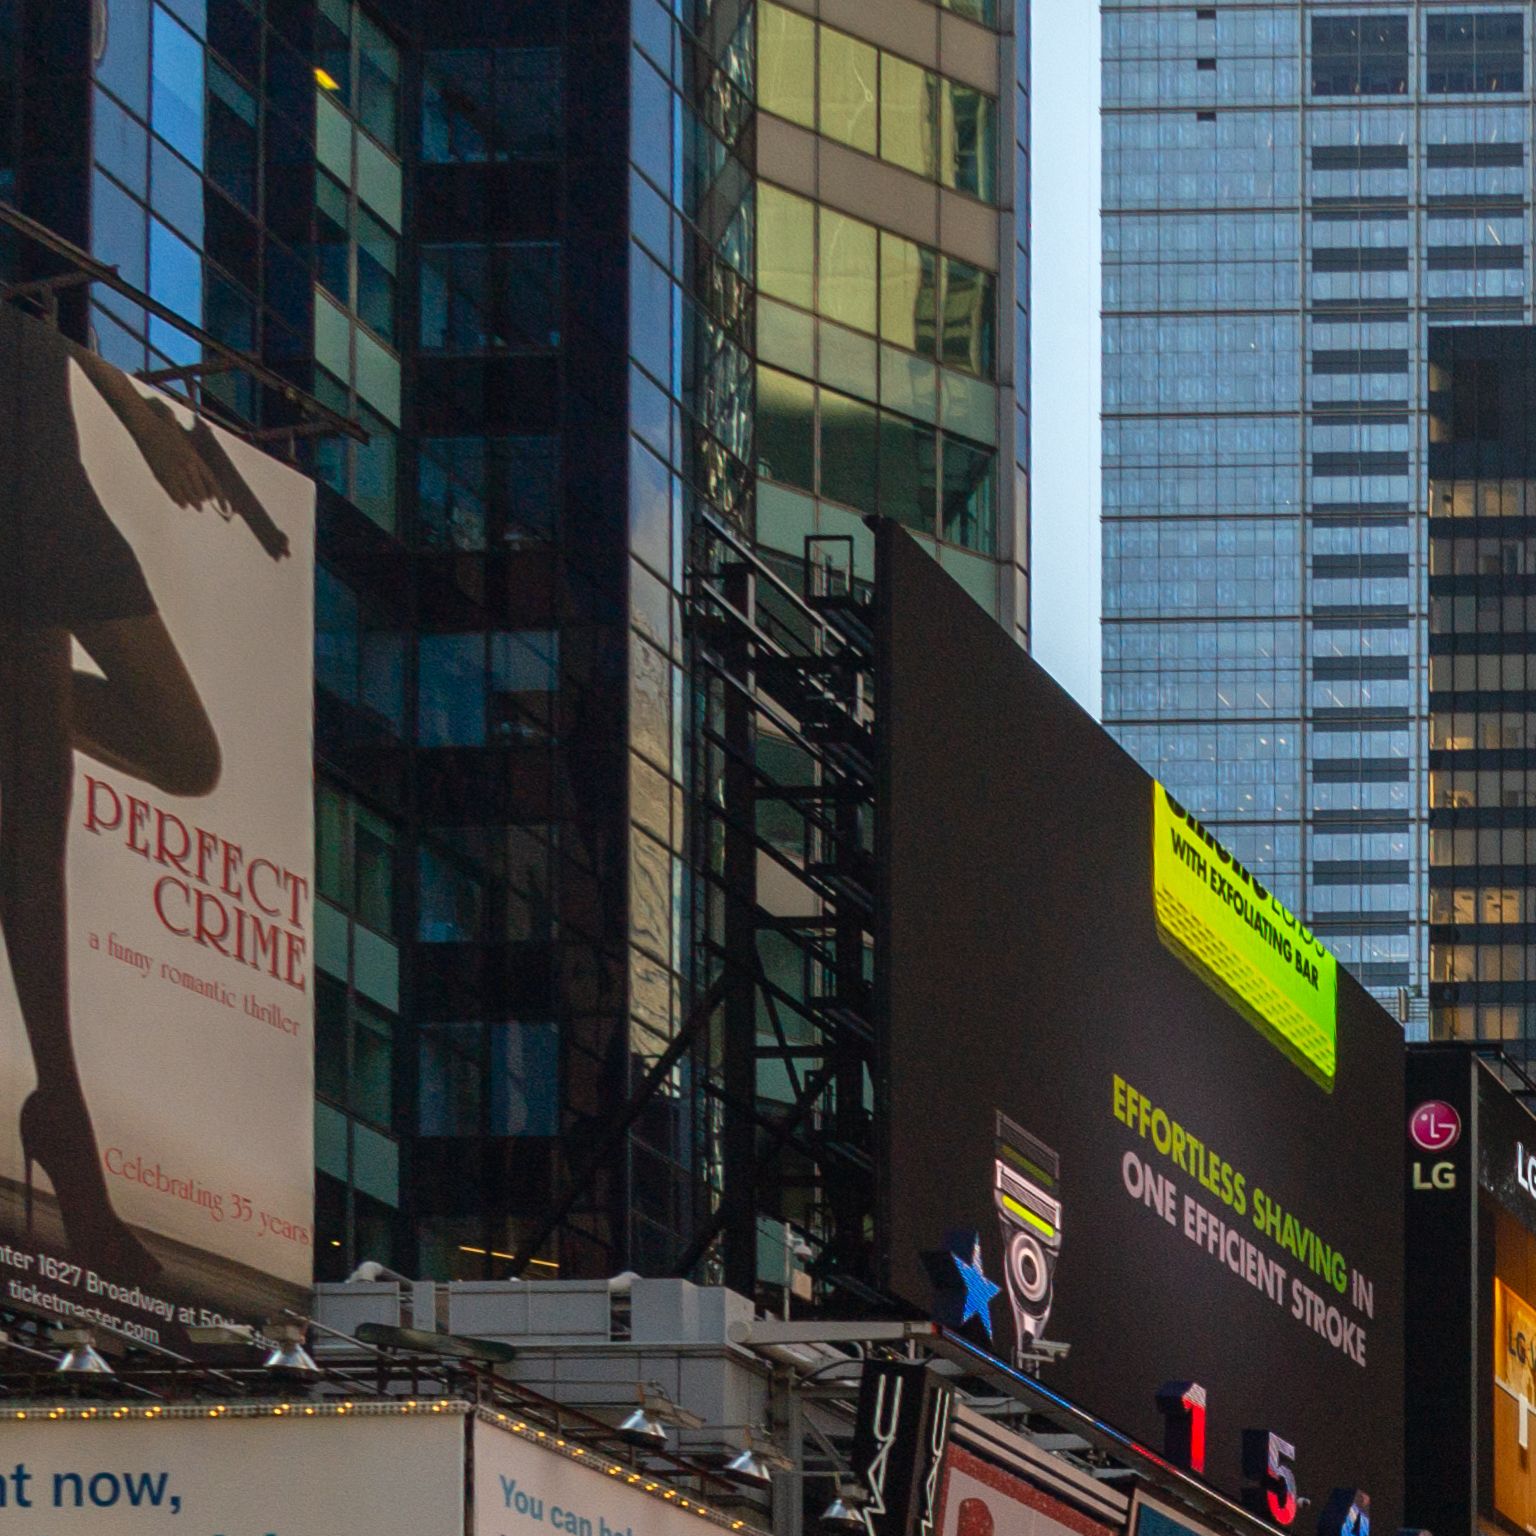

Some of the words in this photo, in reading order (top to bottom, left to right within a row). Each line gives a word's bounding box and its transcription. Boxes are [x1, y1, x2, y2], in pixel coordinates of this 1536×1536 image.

[83, 773, 309, 930] PERFECT
[152, 876, 307, 993] CRIME
[1170, 827, 1208, 883] WITH
[1209, 866, 1294, 963] EXFOLIATING
[1295, 950, 1320, 991] BAR
[107, 932, 153, 979] funny
[160, 962, 238, 1018] romantic
[242, 991, 300, 1037] thriller
[103, 1147, 224, 1222] Celebrating
[230, 1192, 252, 1222] 35
[1113, 1073, 1246, 1216] EFFORTLESS
[1253, 1187, 1347, 1294] SHAVING
[1352, 1268, 1374, 1319] IN
[1412, 1162, 1456, 1190] LG
[38, 1253, 82, 1288] 1627
[86, 1271, 174, 1322] Broadway
[178, 1306, 195, 1327] at
[1122, 1151, 1176, 1227] ONE
[1184, 1194, 1287, 1306] EFFICIENT
[1291, 1278, 1367, 1368] STROKE
[8, 1280, 160, 1344] ticketmaster.com
[52, 1471, 181, 1514] now,
[499, 1474, 543, 1522] You
